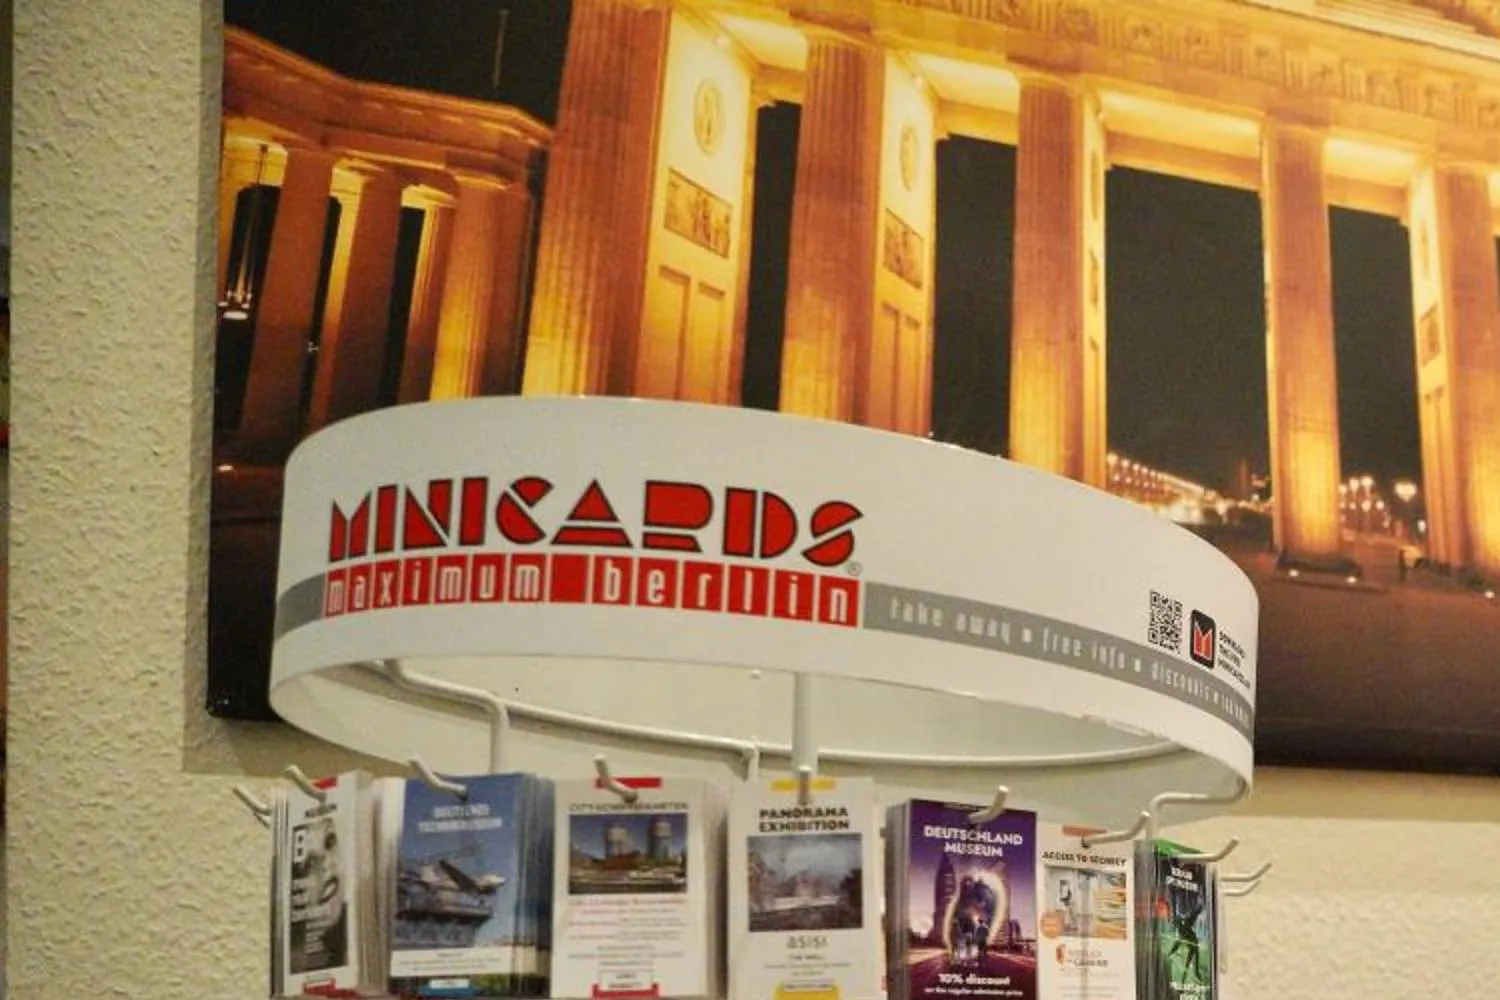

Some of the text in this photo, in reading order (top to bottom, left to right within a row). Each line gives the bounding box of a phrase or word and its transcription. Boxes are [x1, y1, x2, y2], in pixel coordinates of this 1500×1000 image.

[327, 475, 865, 566] MINICARDS
[328, 564, 851, 622] maximum berlin
[889, 597, 943, 628] take
[955, 613, 1011, 646] away
[1042, 625, 1084, 657] free
[1091, 645, 1127, 672] info
[760, 806, 848, 819] PANORAMA
[760, 819, 849, 832] EXHIBITION
[923, 825, 1023, 845] DEUTSCHLAND
[944, 841, 1003, 857] MUSEUM
[938, 973, 1011, 986] 10% discount
